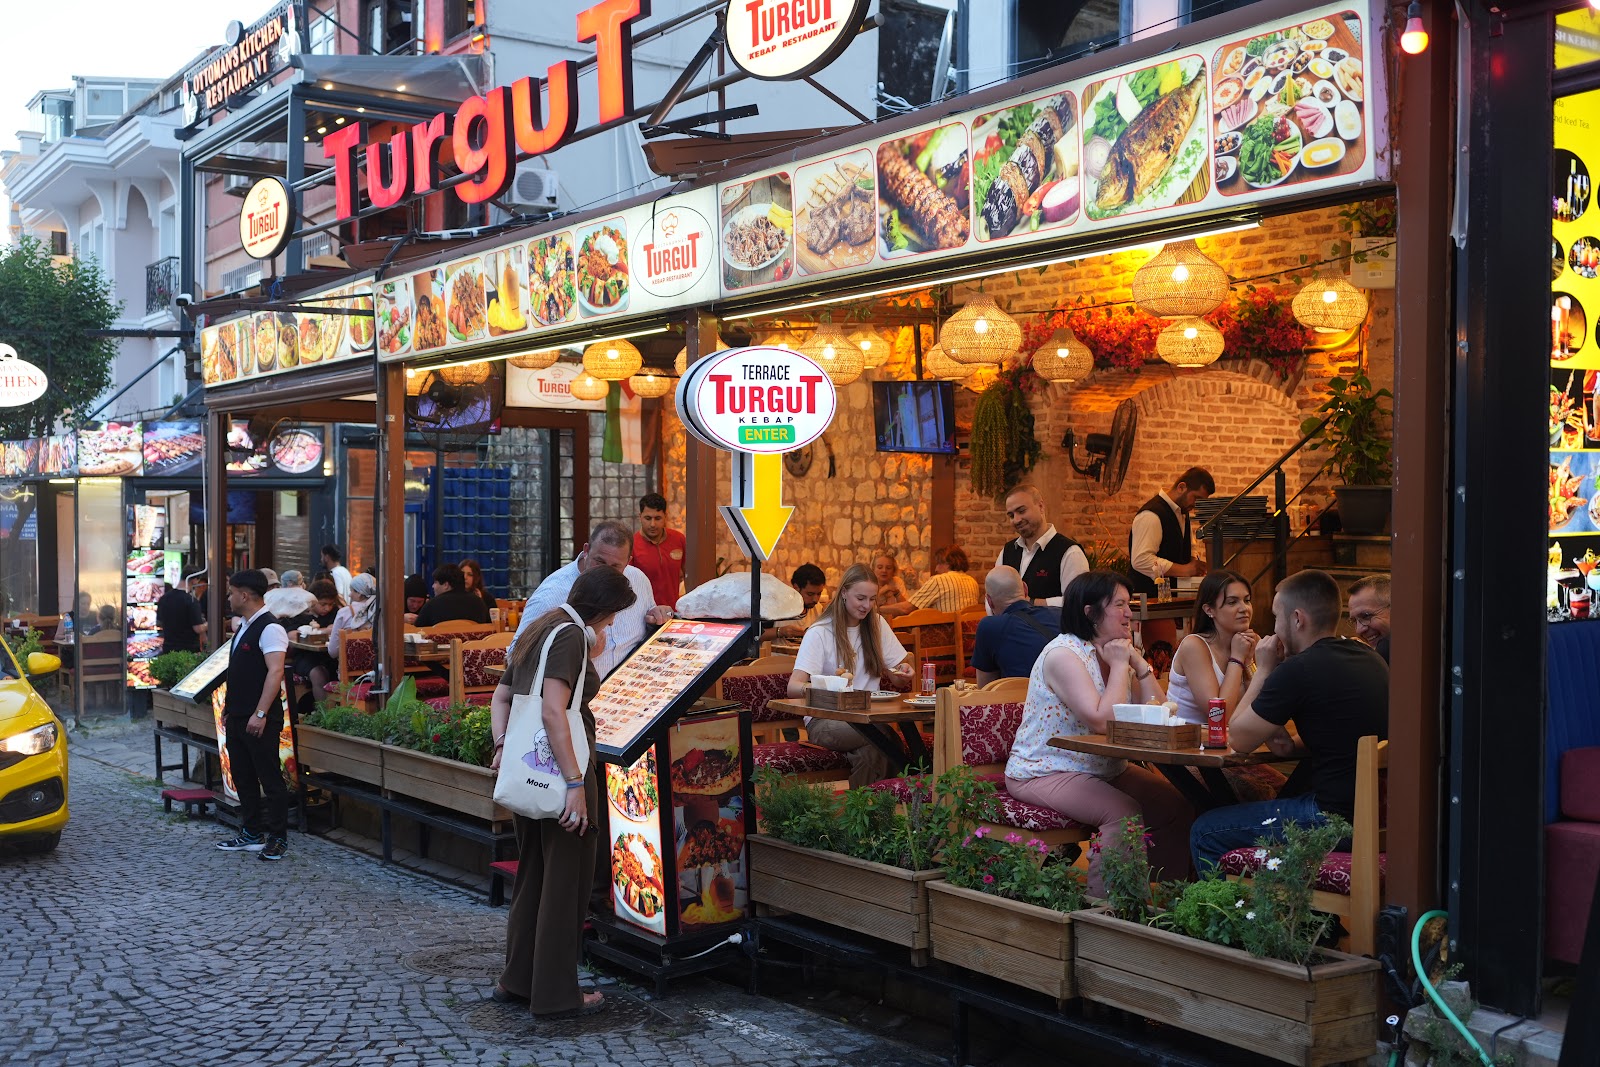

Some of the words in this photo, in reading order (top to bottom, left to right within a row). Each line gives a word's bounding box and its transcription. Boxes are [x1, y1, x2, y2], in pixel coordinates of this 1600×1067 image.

[749, 45, 777, 60] KEBAP
[782, 21, 837, 48] RESTAURANT
[193, 45, 240, 95] OTTOMAN'S
[205, 50, 268, 109] RESTAURANT
[248, 202, 280, 239] TURGUT
[643, 232, 700, 278] TURGUT
[651, 276, 666, 285] KEBAP
[666, 271, 693, 282] RESTAURANT
[742, 364, 790, 380] TERRACE
[709, 375, 823, 414] TURGUT
[739, 416, 794, 424] KEBAP
[745, 427, 788, 441] ENTER
[526, 778, 550, 789] Mood
